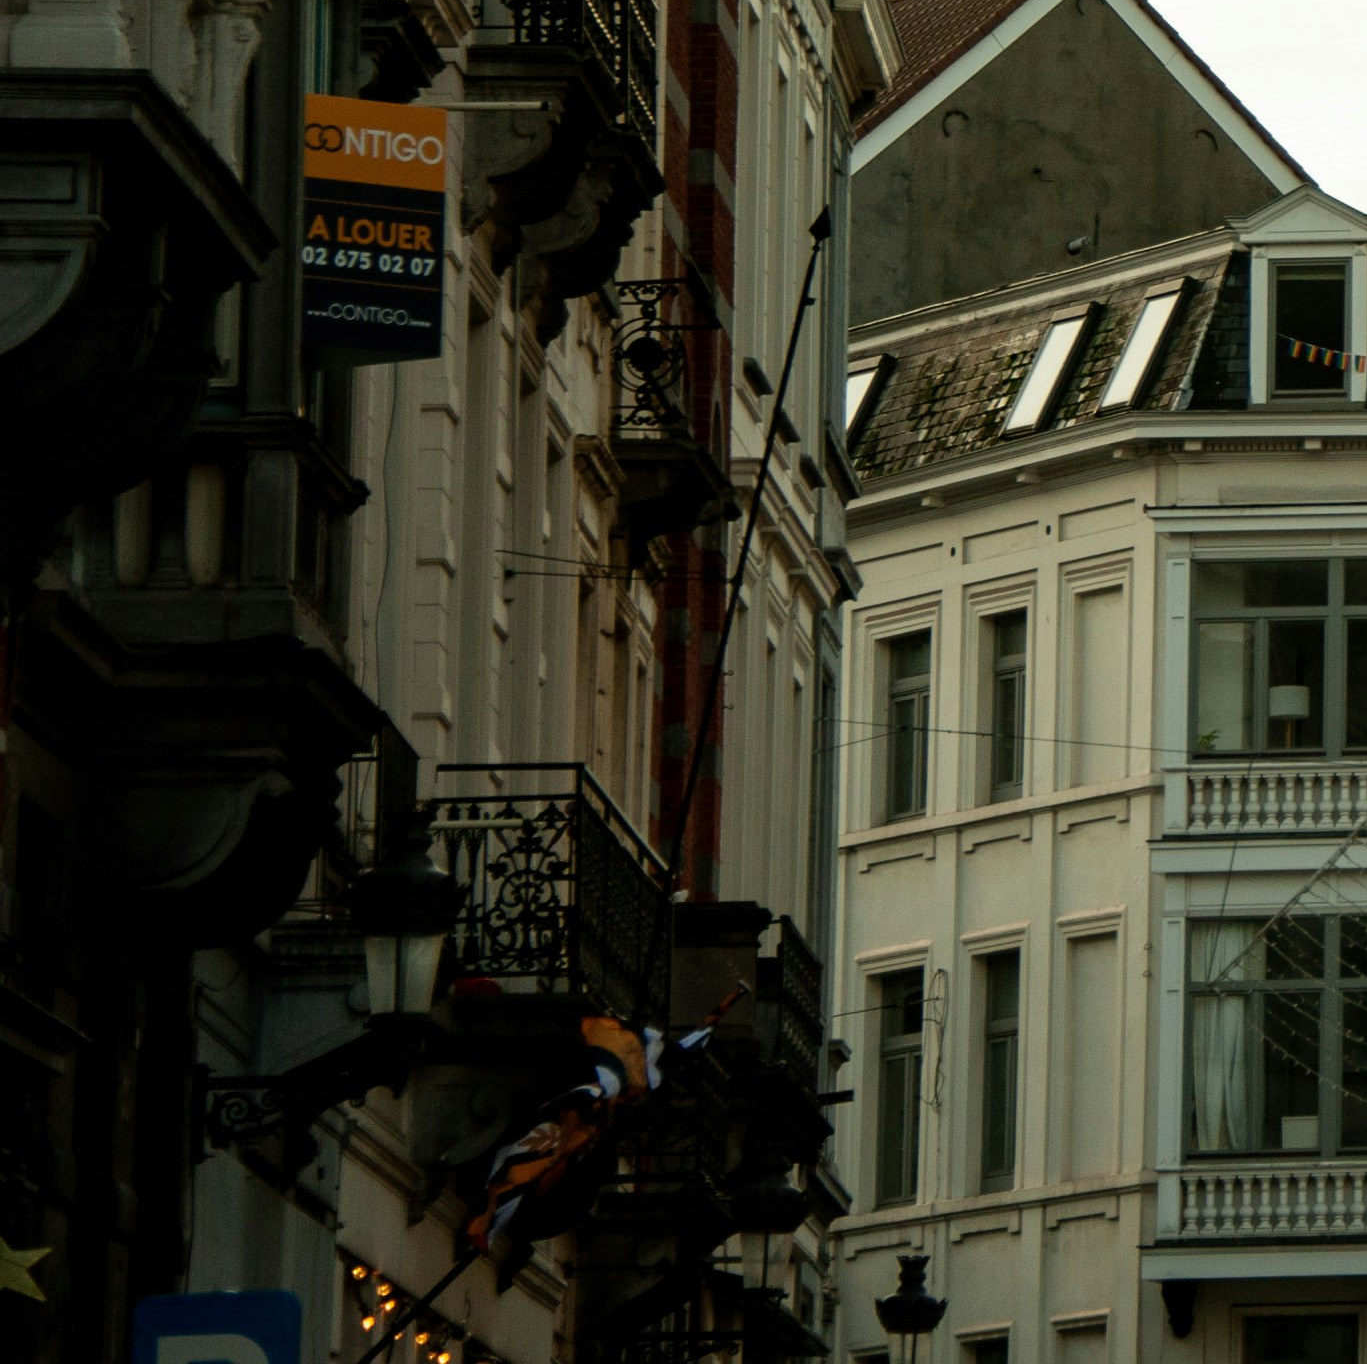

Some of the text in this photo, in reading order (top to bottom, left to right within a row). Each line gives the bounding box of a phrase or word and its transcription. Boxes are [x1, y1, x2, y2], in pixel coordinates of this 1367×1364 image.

[336, 214, 435, 253] LOUER
[301, 245, 436, 277] 02 675 02 07
